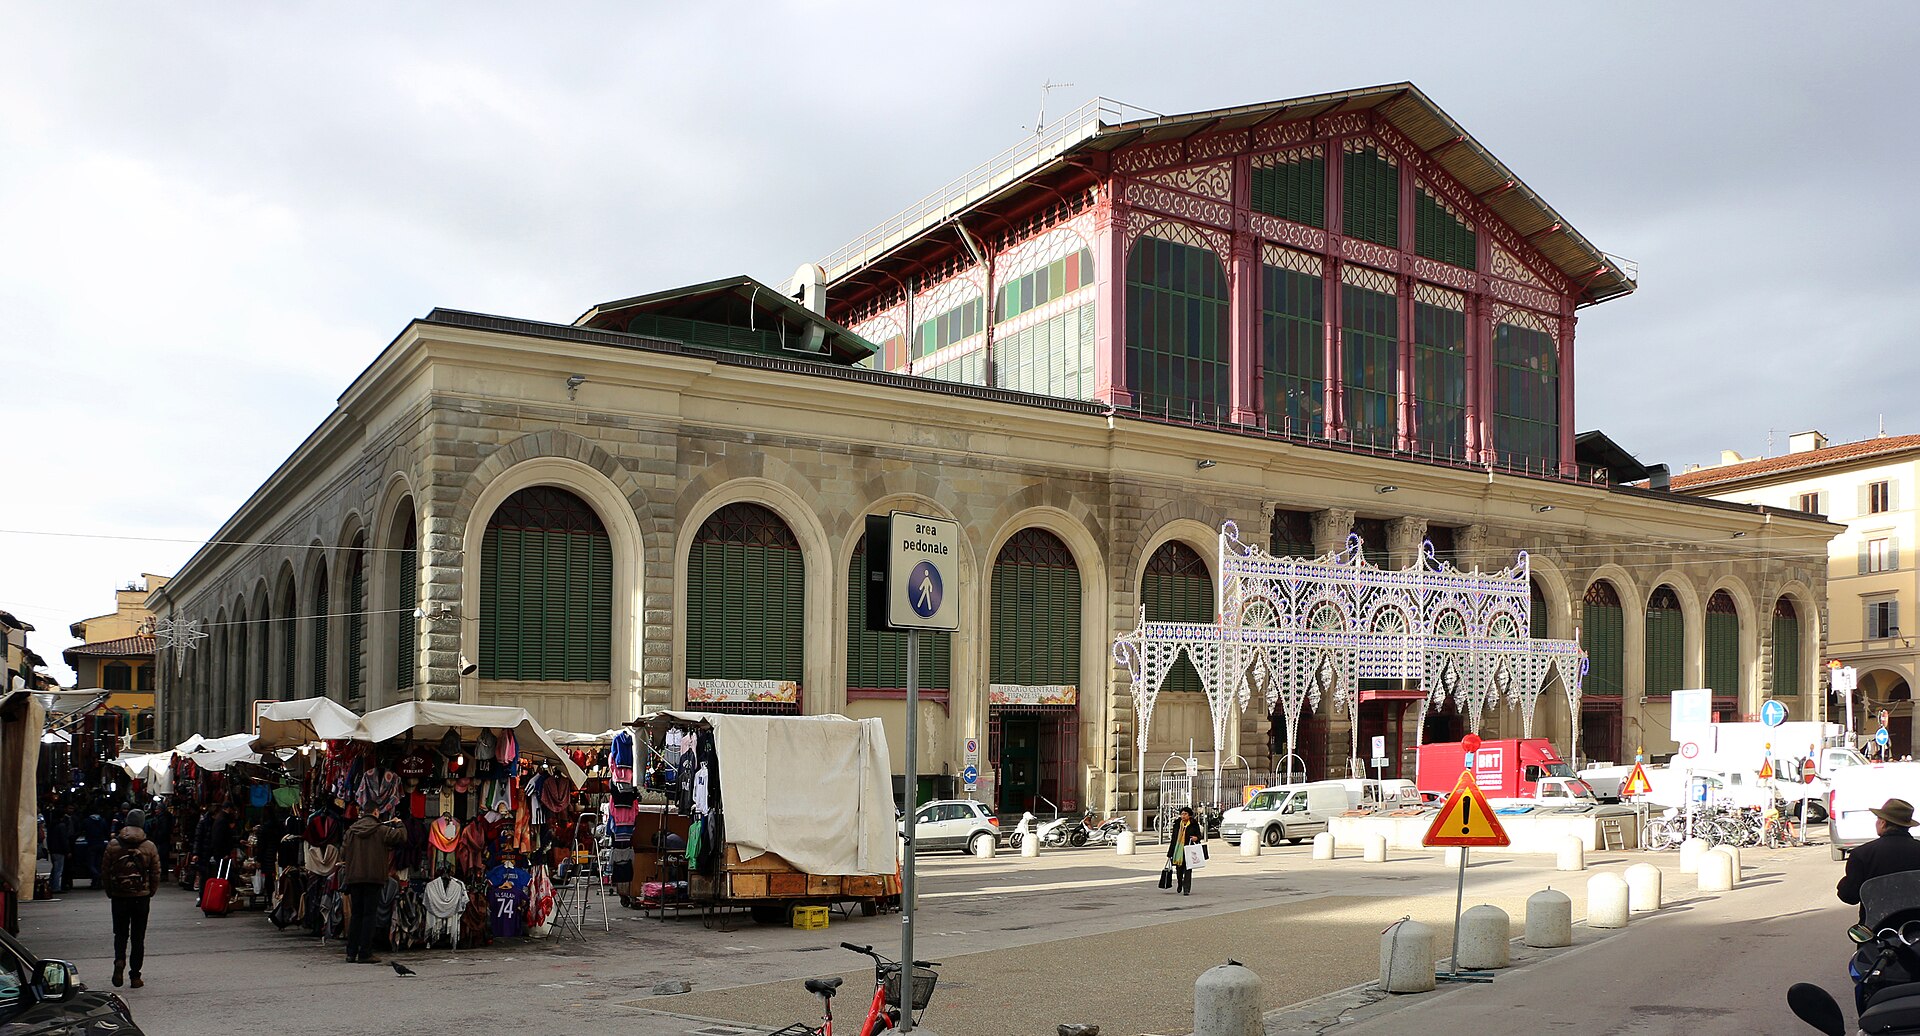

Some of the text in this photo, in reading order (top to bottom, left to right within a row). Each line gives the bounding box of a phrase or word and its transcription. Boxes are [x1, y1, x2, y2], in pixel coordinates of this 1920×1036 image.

[915, 523, 937, 536] area
[903, 539, 948, 555] pedonale
[698, 681, 776, 689] MERCATO CENTRALE
[998, 685, 1028, 693] MERCATO
[710, 688, 739, 696] FIRENZE
[1478, 753, 1500, 769] BRT
[497, 898, 514, 919] 74
